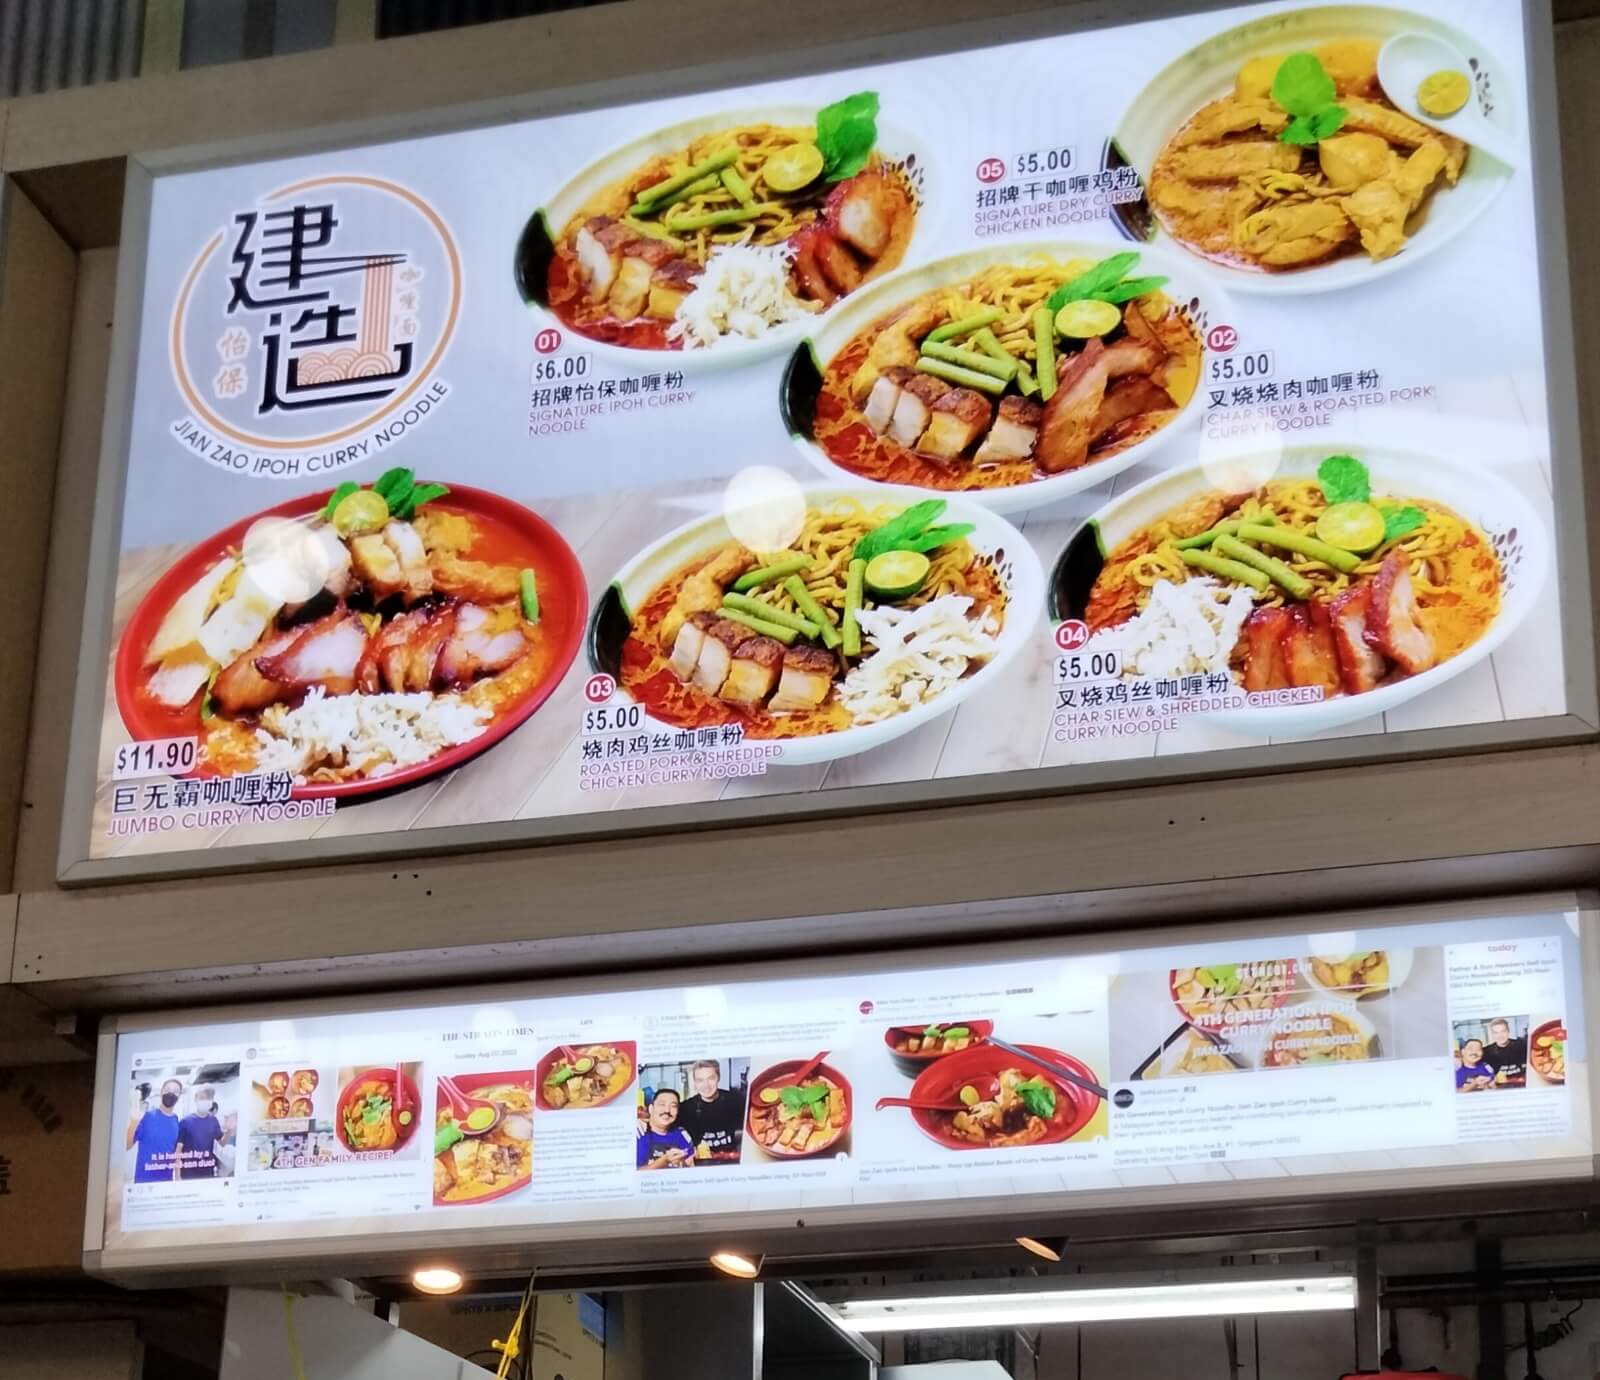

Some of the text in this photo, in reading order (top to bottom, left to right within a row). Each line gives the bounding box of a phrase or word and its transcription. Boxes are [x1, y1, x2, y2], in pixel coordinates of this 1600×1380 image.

[979, 162, 1002, 179] 05
[1017, 149, 1071, 174] $5.00
[976, 166, 1138, 208] 招牌干咖喱鸡粉
[975, 188, 1142, 223] SIGNATURE DRY CURRY
[975, 206, 1108, 236] CHICKEN NOODLE
[538, 332, 559, 349] 01
[1210, 329, 1236, 348] 02
[535, 355, 587, 381] $6.00
[1211, 353, 1269, 380] $5.00
[531, 369, 684, 408] 招牌怡保咖喱粉
[529, 390, 695, 423] SIGNATURE IPOH CURRY
[1208, 385, 1434, 426] CHAR SIEW & ROASTED PORK
[174, 381, 448, 475] JIAN ZAO IPOH CURRY NOODLE
[528, 419, 586, 436] NOODLE
[1264, 414, 1331, 432] NOODLE
[1059, 626, 1086, 644] 04
[1059, 652, 1117, 678] $5.00
[590, 680, 612, 696] 03
[586, 705, 640, 731] $5.00
[1055, 688, 1322, 726] CHAR SIEW & SHREDDED CHICKEN
[1055, 718, 1178, 742] CURRY NOODLE
[117, 741, 194, 771] $11.90
[580, 745, 783, 776] ROASTED PORK & SHREDDED
[579, 762, 766, 791] CHICKEN CURRY NOODLE
[113, 771, 293, 813] 巨无霸咖喱粉
[107, 799, 336, 836] JUMBO CURRY NOODLE
[274, 1157, 294, 1168] 4TH
